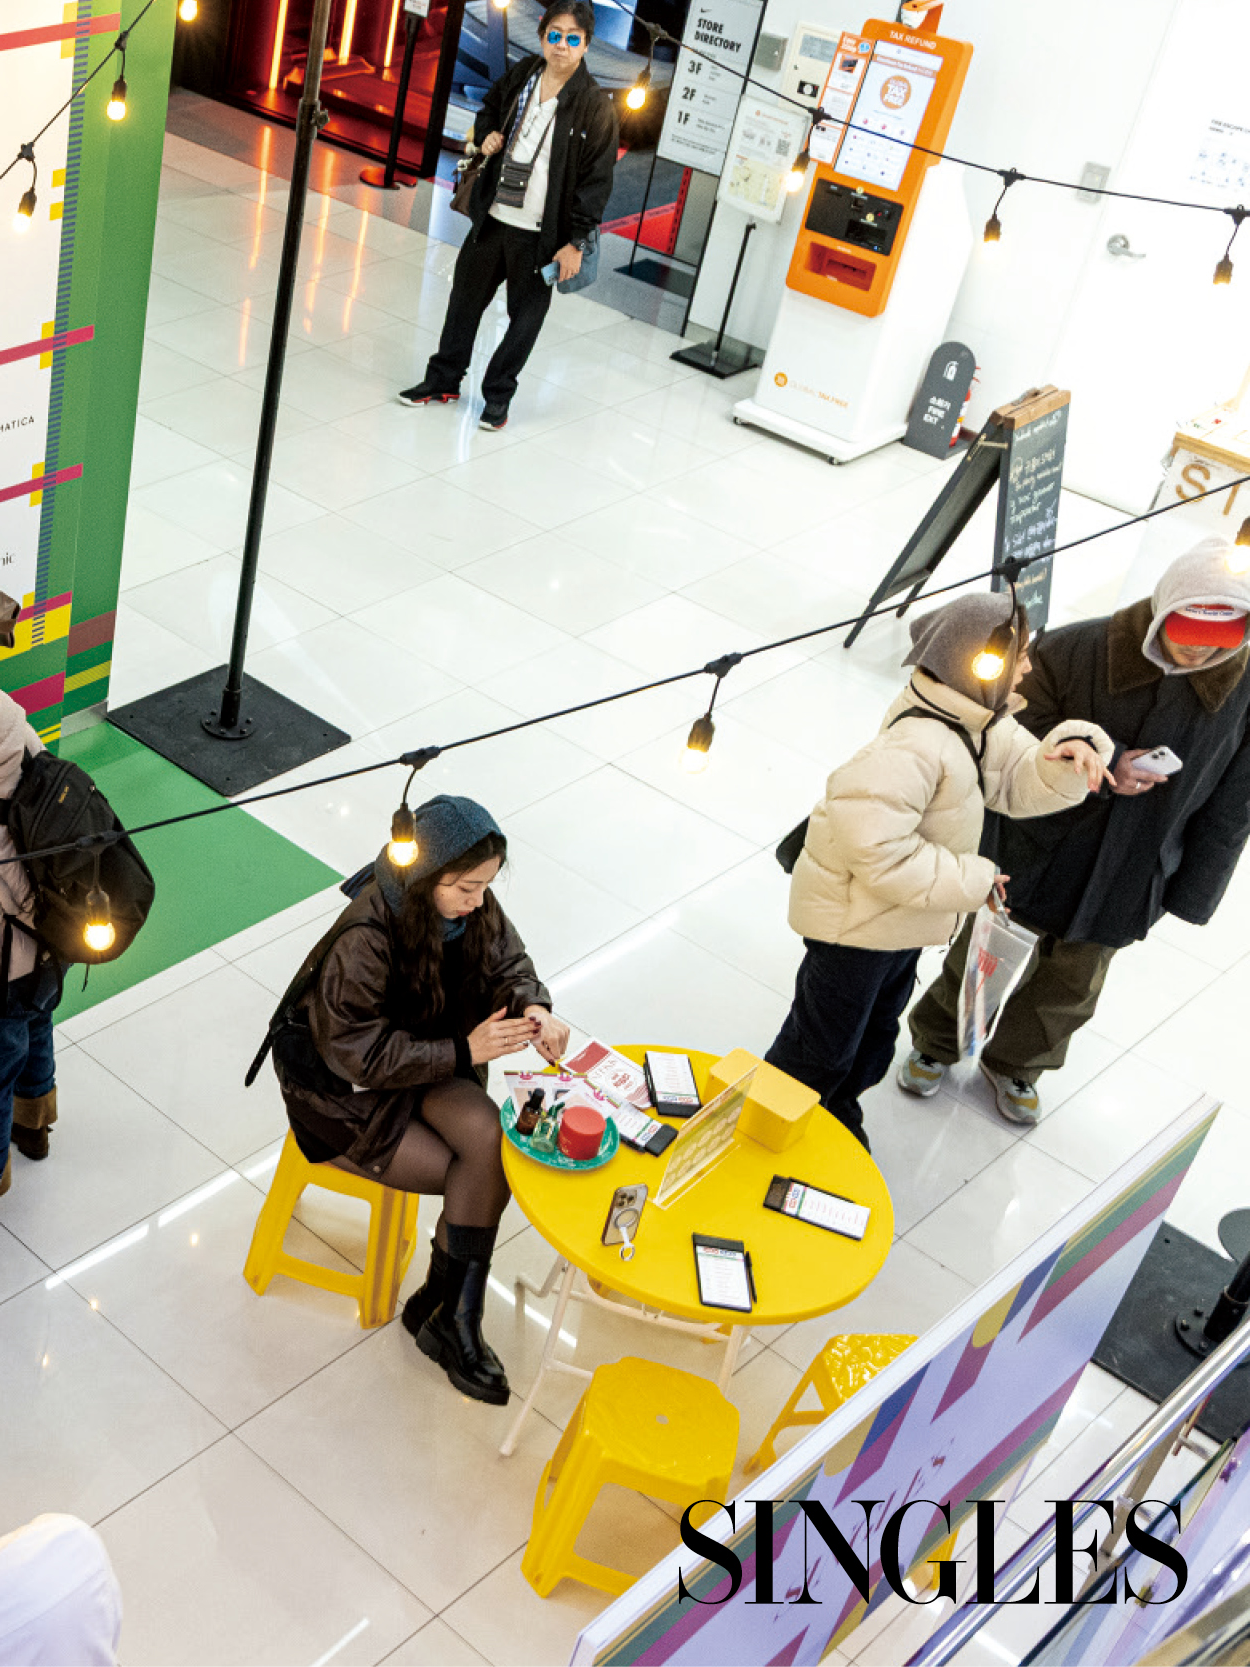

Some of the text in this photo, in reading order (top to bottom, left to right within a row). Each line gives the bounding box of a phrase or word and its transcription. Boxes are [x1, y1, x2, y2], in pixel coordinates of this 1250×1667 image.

[697, 18, 724, 33] STORE
[694, 30, 742, 53] DIRECTORY
[889, 30, 937, 50] TAX REFUND
[688, 60, 703, 75] 3F
[681, 86, 697, 101] 2F
[677, 110, 690, 125] 1F
